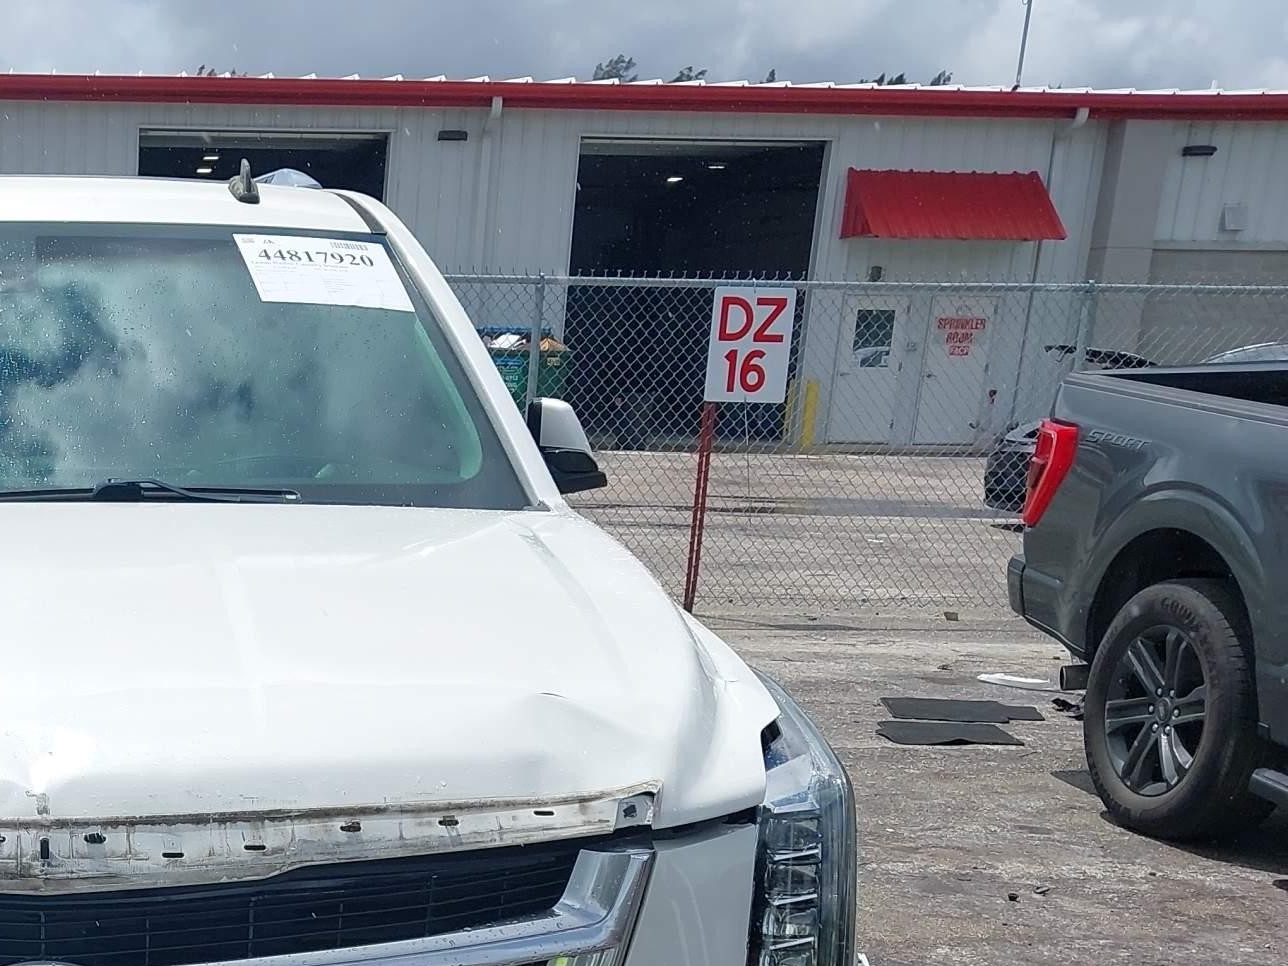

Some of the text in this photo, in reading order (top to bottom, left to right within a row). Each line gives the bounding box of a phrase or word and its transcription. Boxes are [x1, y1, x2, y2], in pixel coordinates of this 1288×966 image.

[258, 248, 374, 267] 44817920
[718, 296, 788, 342] DZ
[937, 318, 986, 330] SPRINKLER
[945, 332, 972, 344] ROOM
[724, 349, 767, 393] 16
[1085, 428, 1152, 449] SPORT
